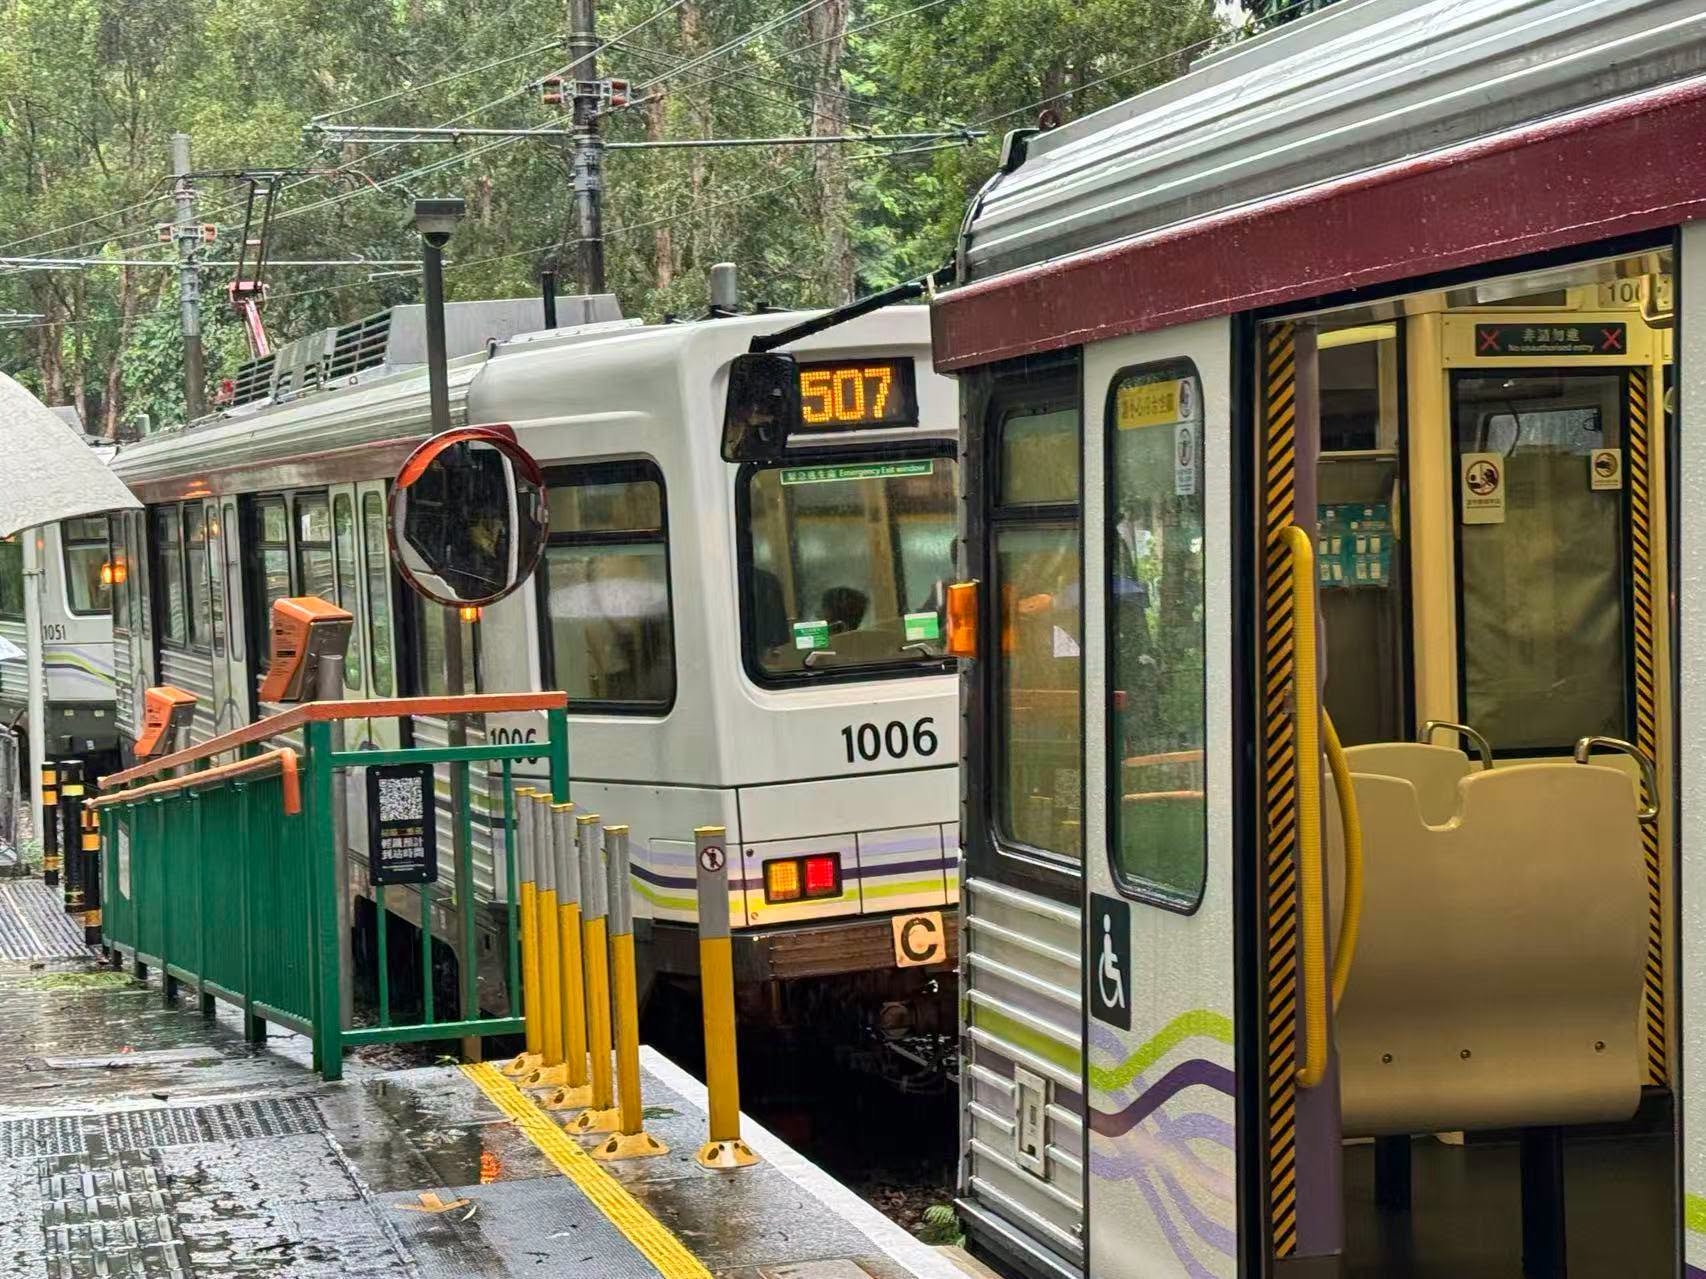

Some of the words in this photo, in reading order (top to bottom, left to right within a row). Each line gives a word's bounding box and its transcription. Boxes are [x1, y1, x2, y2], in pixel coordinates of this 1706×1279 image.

[801, 367, 891, 423] 507
[839, 468, 880, 478] Emergency
[881, 465, 895, 474] Exit
[896, 464, 926, 473] window
[43, 624, 66, 640] 1051
[841, 716, 938, 763] 1006
[901, 917, 938, 962] C
